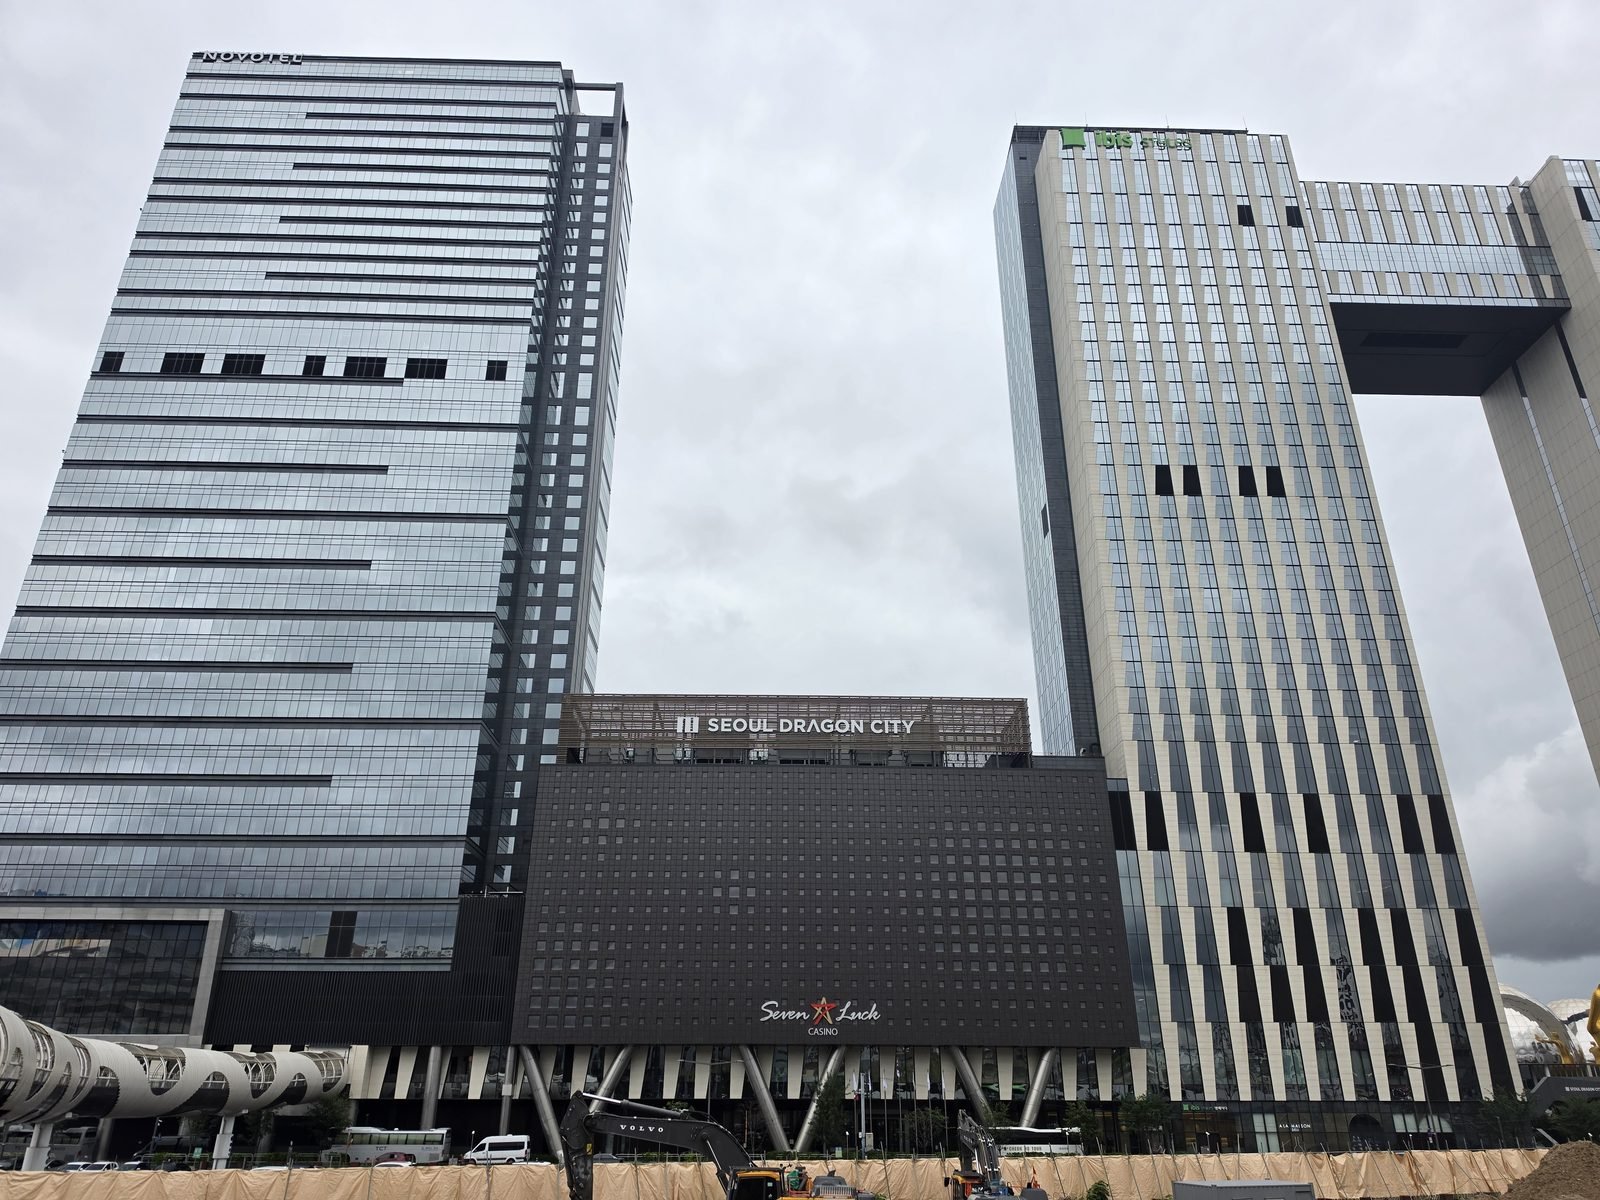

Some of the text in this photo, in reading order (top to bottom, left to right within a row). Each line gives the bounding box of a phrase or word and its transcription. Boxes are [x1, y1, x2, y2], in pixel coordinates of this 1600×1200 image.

[202, 50, 303, 64] NOVOTEL
[1095, 130, 1192, 150] ibis styles
[707, 717, 915, 735] SEOUL DRAGON CITY
[760, 1000, 881, 1022] Seven Luck
[808, 1027, 839, 1036] CASINO
[619, 1124, 664, 1133] VOLVO
